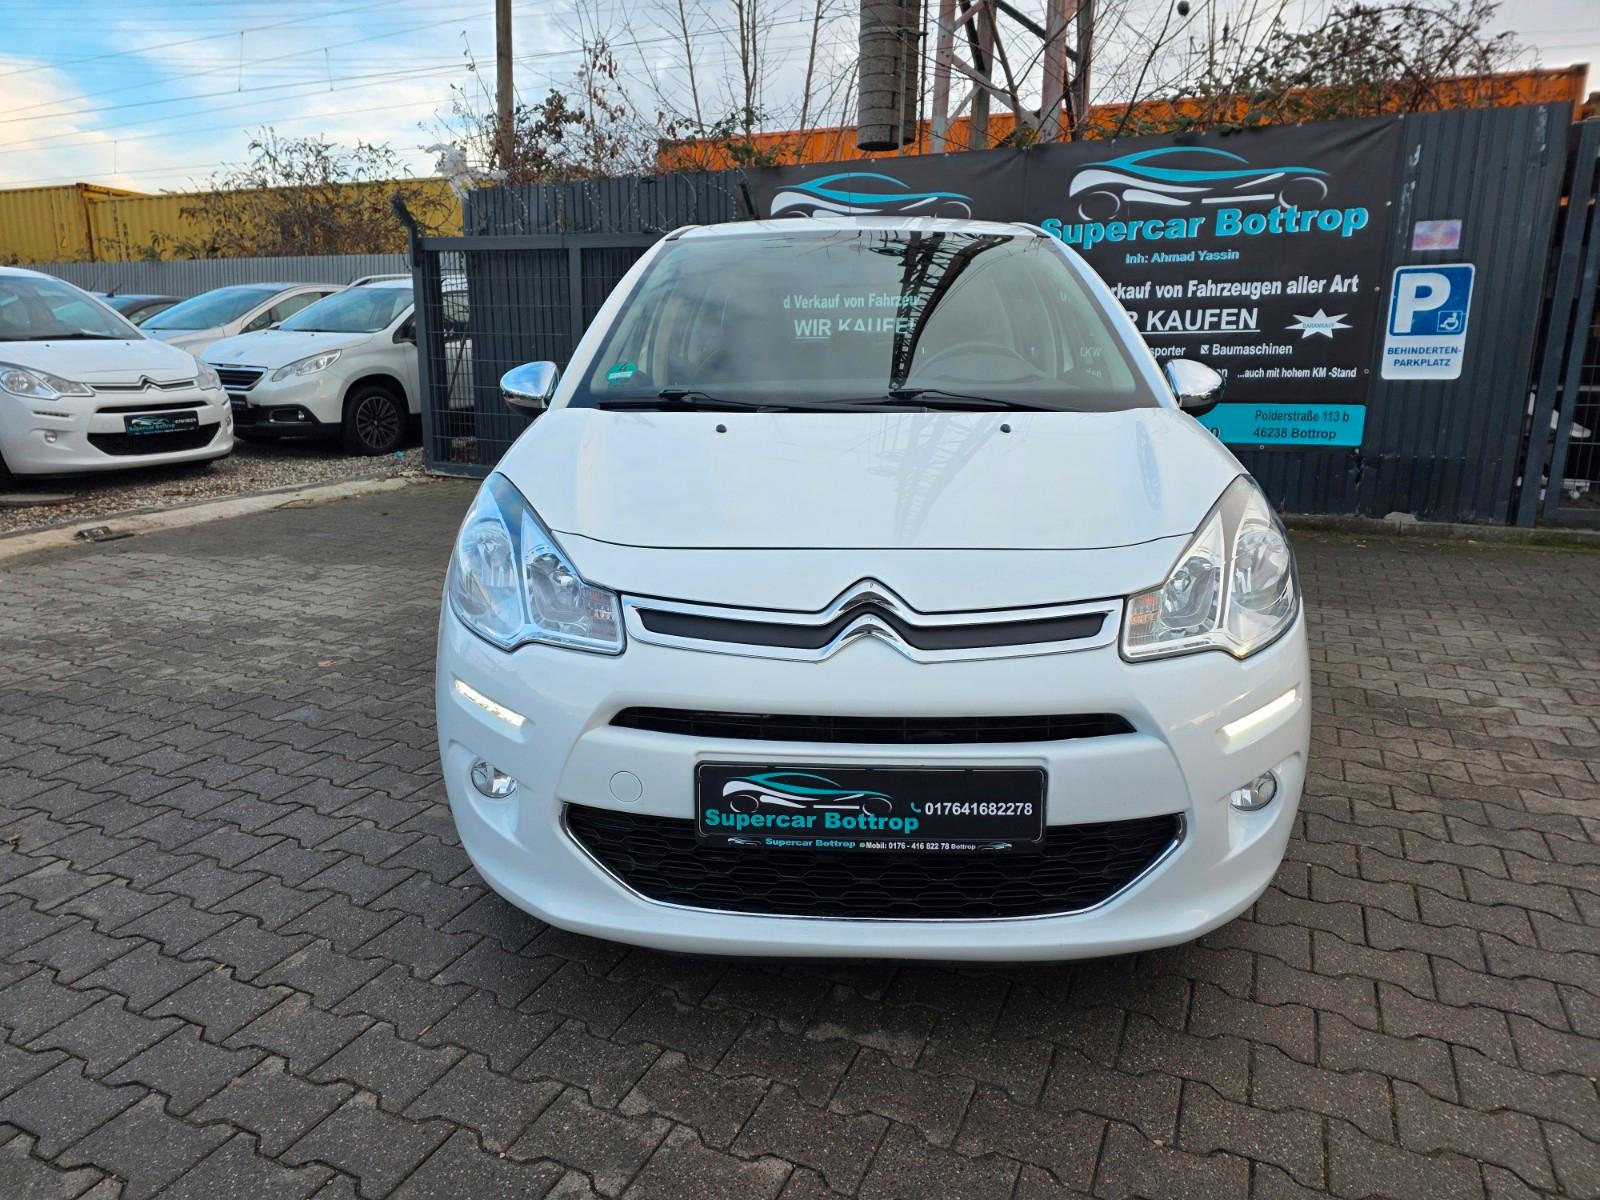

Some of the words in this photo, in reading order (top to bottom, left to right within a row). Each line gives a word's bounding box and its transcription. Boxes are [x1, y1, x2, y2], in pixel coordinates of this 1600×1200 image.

[1041, 216, 1205, 249] Supercar
[1215, 207, 1368, 237] Bottrop
[1125, 253, 1148, 264] Inh:
[1151, 251, 1194, 263] Ahmad
[1198, 249, 1239, 261] Yassin
[1155, 285, 1182, 298] von
[1187, 278, 1282, 299] Fahrzeugen
[1286, 276, 1327, 295] aller
[1329, 274, 1359, 292] Art
[793, 293, 839, 309] Verkauf
[843, 297, 864, 308] von
[1393, 272, 1451, 333] P
[1146, 308, 1259, 331] KAUFEN
[794, 318, 832, 336] WIR
[1212, 344, 1293, 355] Baumaschinen
[1387, 346, 1462, 355] BEHINDERTEN-
[1393, 358, 1452, 367] PARKPLATZ
[1266, 368, 1279, 377] mit
[1281, 368, 1309, 377] hohem
[1312, 367, 1327, 377] KM
[1328, 367, 1357, 378] -Stand
[1255, 410, 1319, 422] Polderstraße
[1322, 411, 1339, 422] 113
[1342, 411, 1350, 422] b
[1254, 428, 1287, 438] 46238
[1291, 428, 1337, 441] Bottrop
[924, 802, 1033, 816] 017641682278
[705, 809, 816, 830] Supercar
[824, 812, 919, 833] Bottrop
[765, 838, 813, 847] Supercar
[815, 840, 856, 848] Bottrop
[888, 842, 906, 850] 0176
